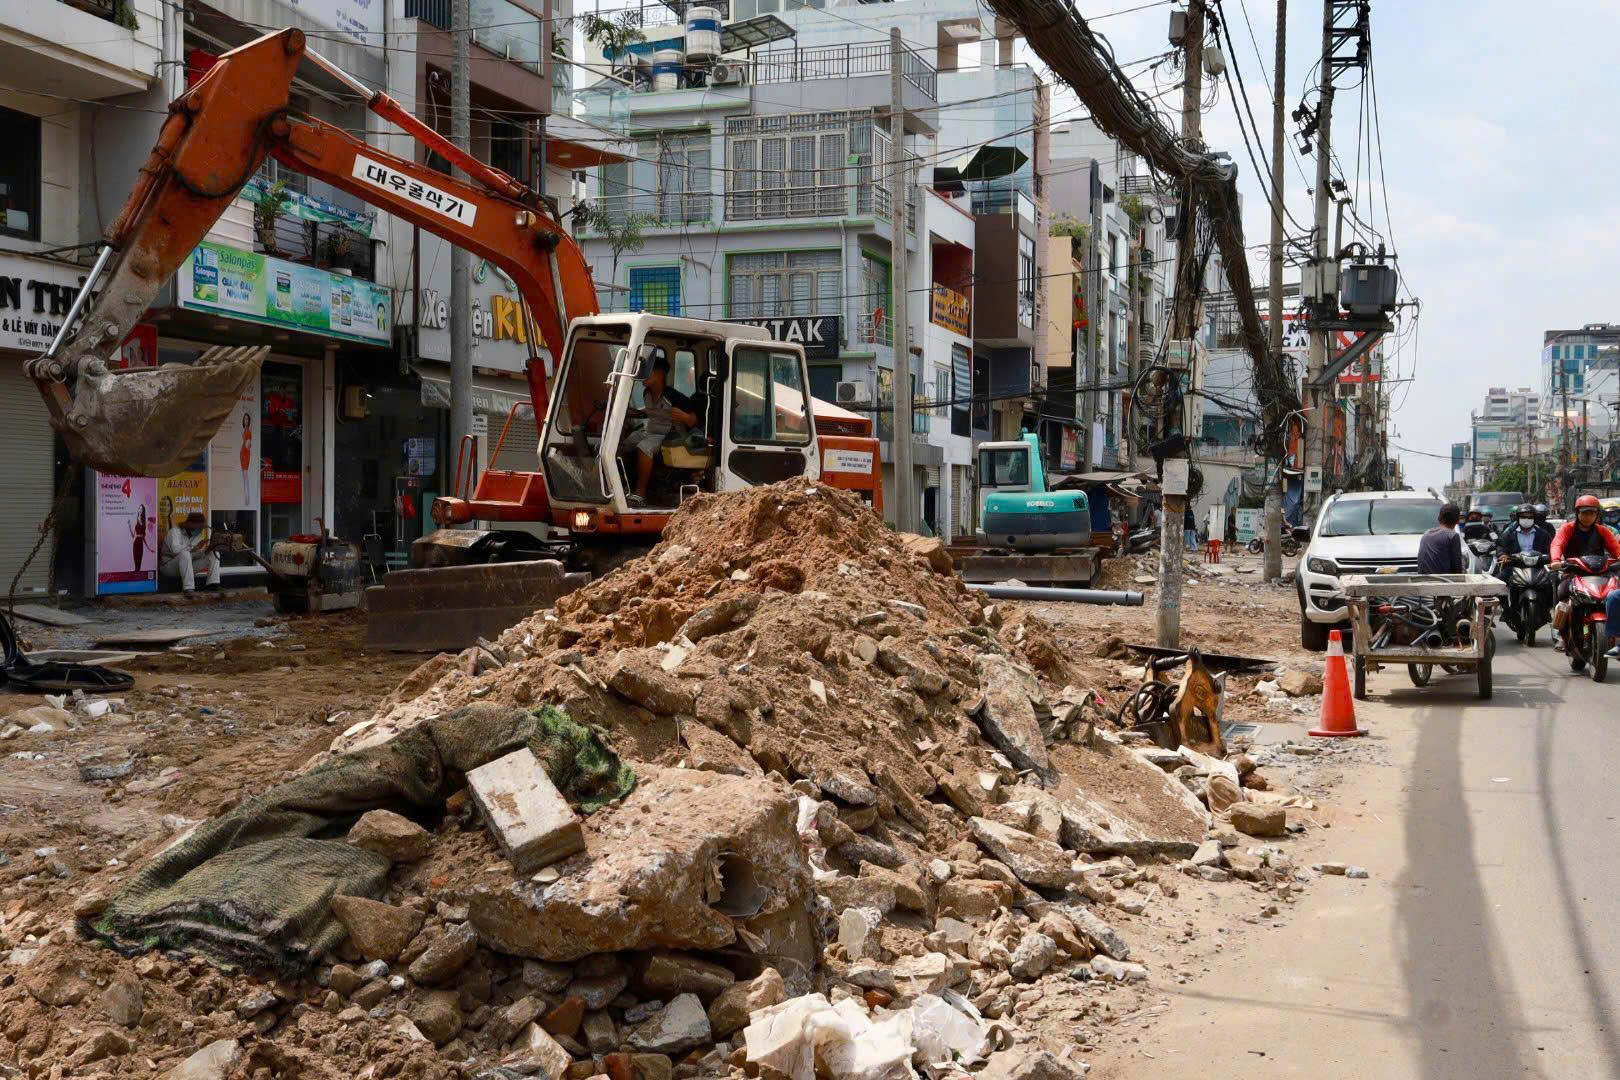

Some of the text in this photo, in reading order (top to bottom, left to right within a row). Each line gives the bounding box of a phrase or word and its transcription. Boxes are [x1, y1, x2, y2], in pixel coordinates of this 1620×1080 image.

[366, 164, 464, 219] 대우굴삭기
[220, 250, 257, 270] Salonpas
[421, 288, 448, 329] Xe
[2, 318, 10, 332] &
